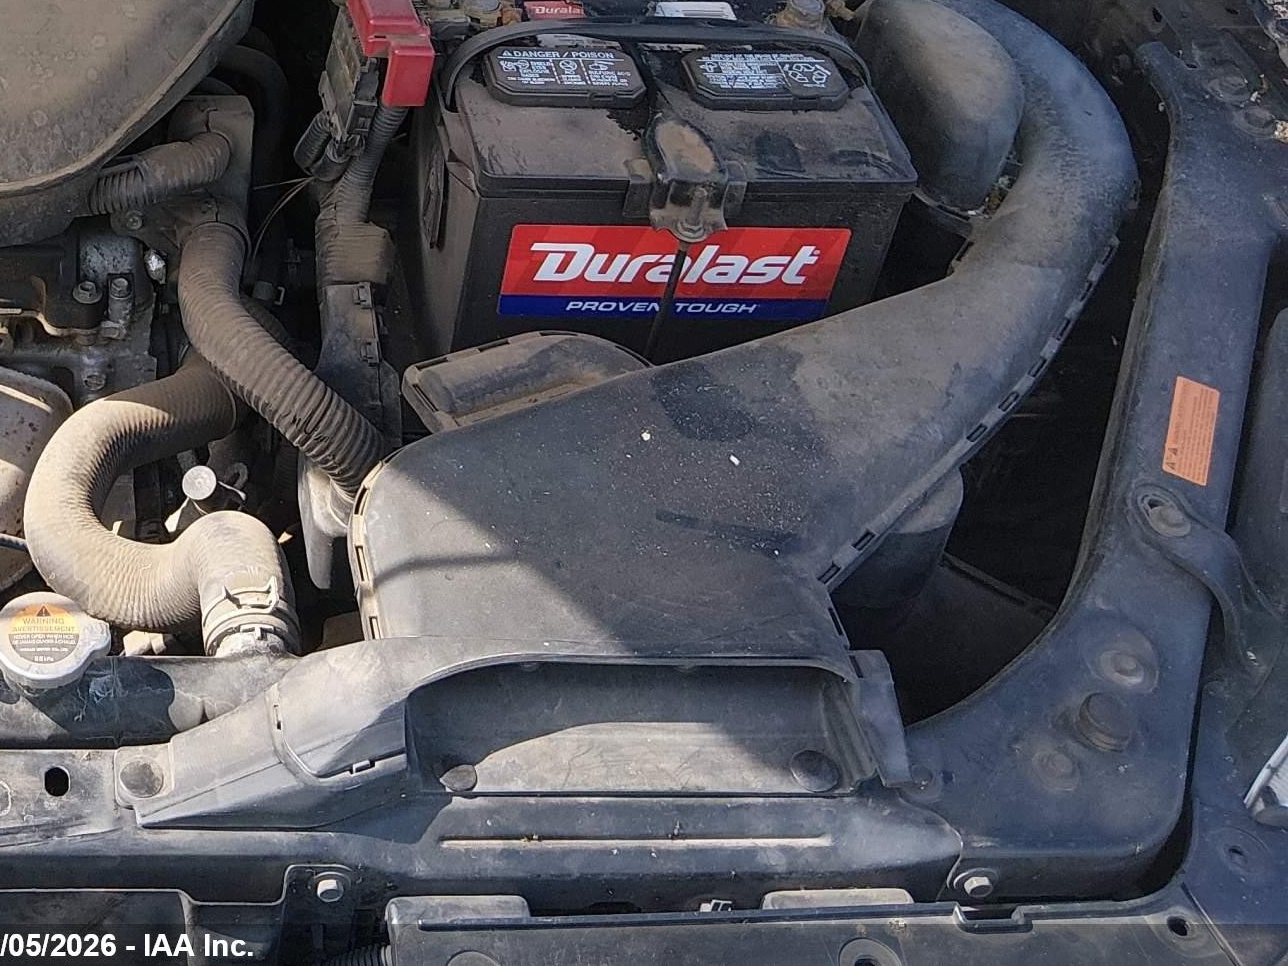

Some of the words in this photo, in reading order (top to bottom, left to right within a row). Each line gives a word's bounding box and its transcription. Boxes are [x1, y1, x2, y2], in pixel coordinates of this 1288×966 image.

[513, 50, 560, 58] DANGER
[571, 51, 615, 59] POISON
[530, 242, 820, 284] Duralast
[566, 301, 661, 312] PROVEN
[675, 302, 758, 313] TOUGH
[23, 617, 65, 625] WARNING
